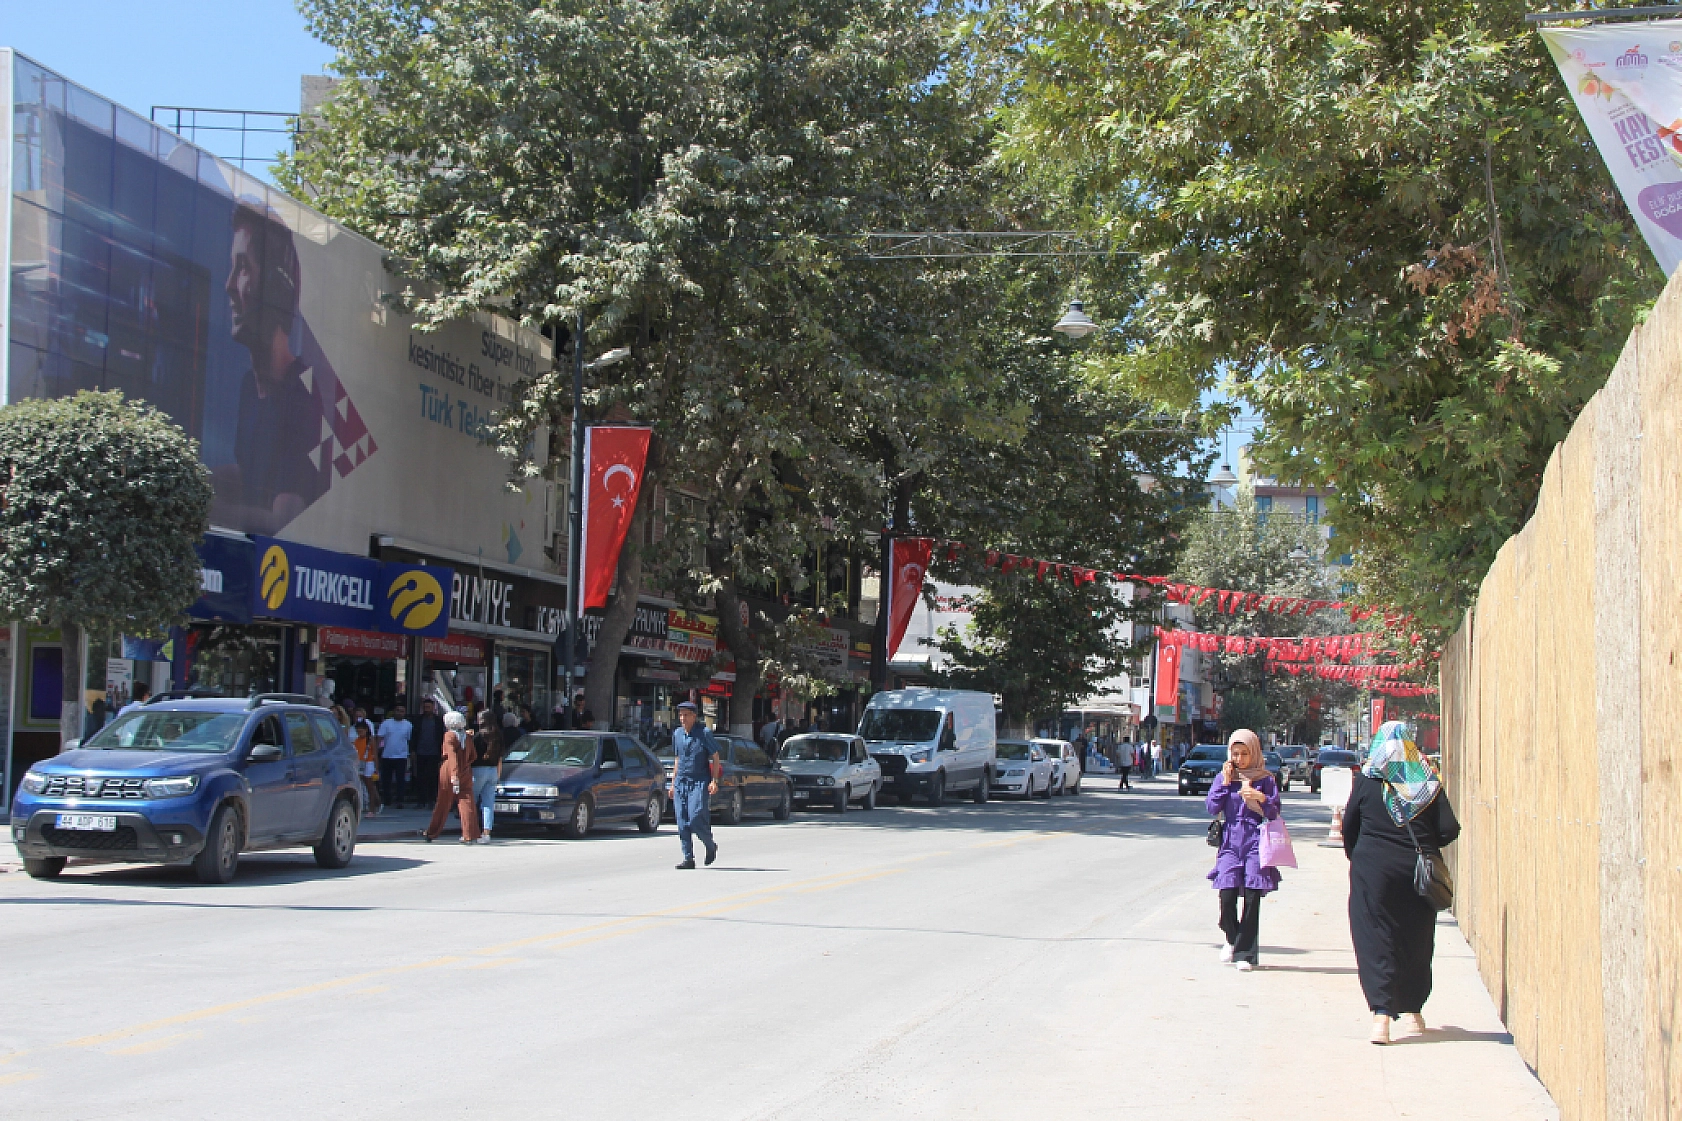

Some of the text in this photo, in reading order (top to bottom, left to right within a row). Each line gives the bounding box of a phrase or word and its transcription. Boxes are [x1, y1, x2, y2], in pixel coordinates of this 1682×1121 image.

[1613, 112, 1652, 145] KAY
[1625, 133, 1668, 169] FEST
[408, 334, 465, 386] kesintisiz
[468, 362, 494, 398] fiber
[482, 329, 514, 368] Süper
[419, 383, 454, 429] Türk
[294, 564, 374, 611] TURKCELL
